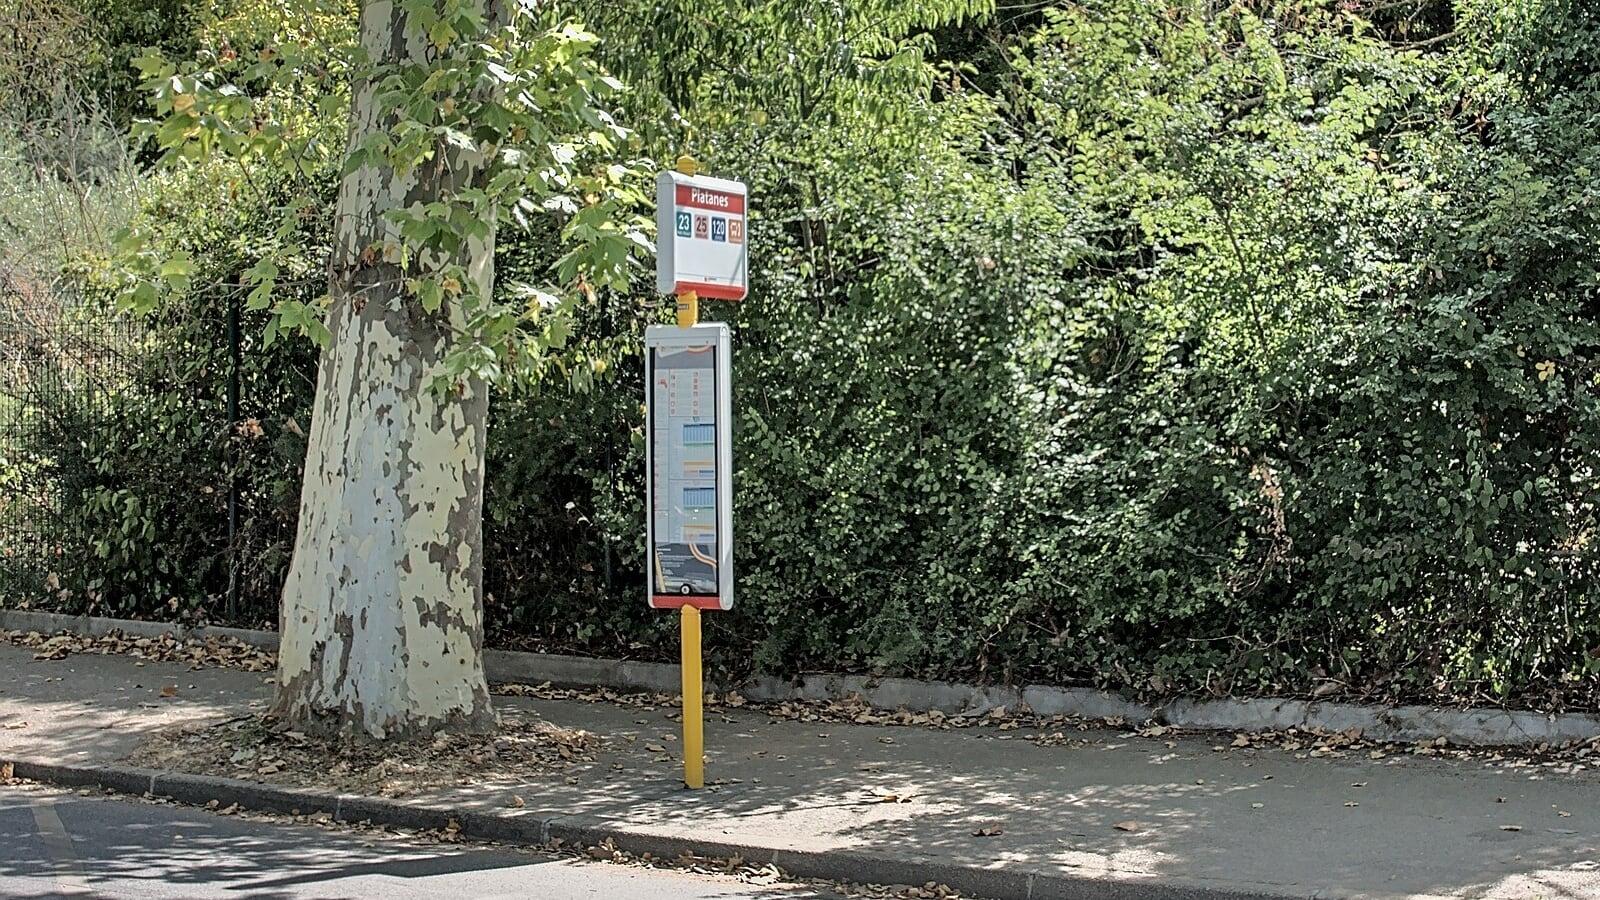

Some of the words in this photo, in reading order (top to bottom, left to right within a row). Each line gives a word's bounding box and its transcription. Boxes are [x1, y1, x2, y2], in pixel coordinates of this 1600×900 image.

[691, 187, 729, 208] Platanes
[678, 214, 690, 231] 23
[696, 216, 707, 233] 25
[712, 220, 725, 235] 120
